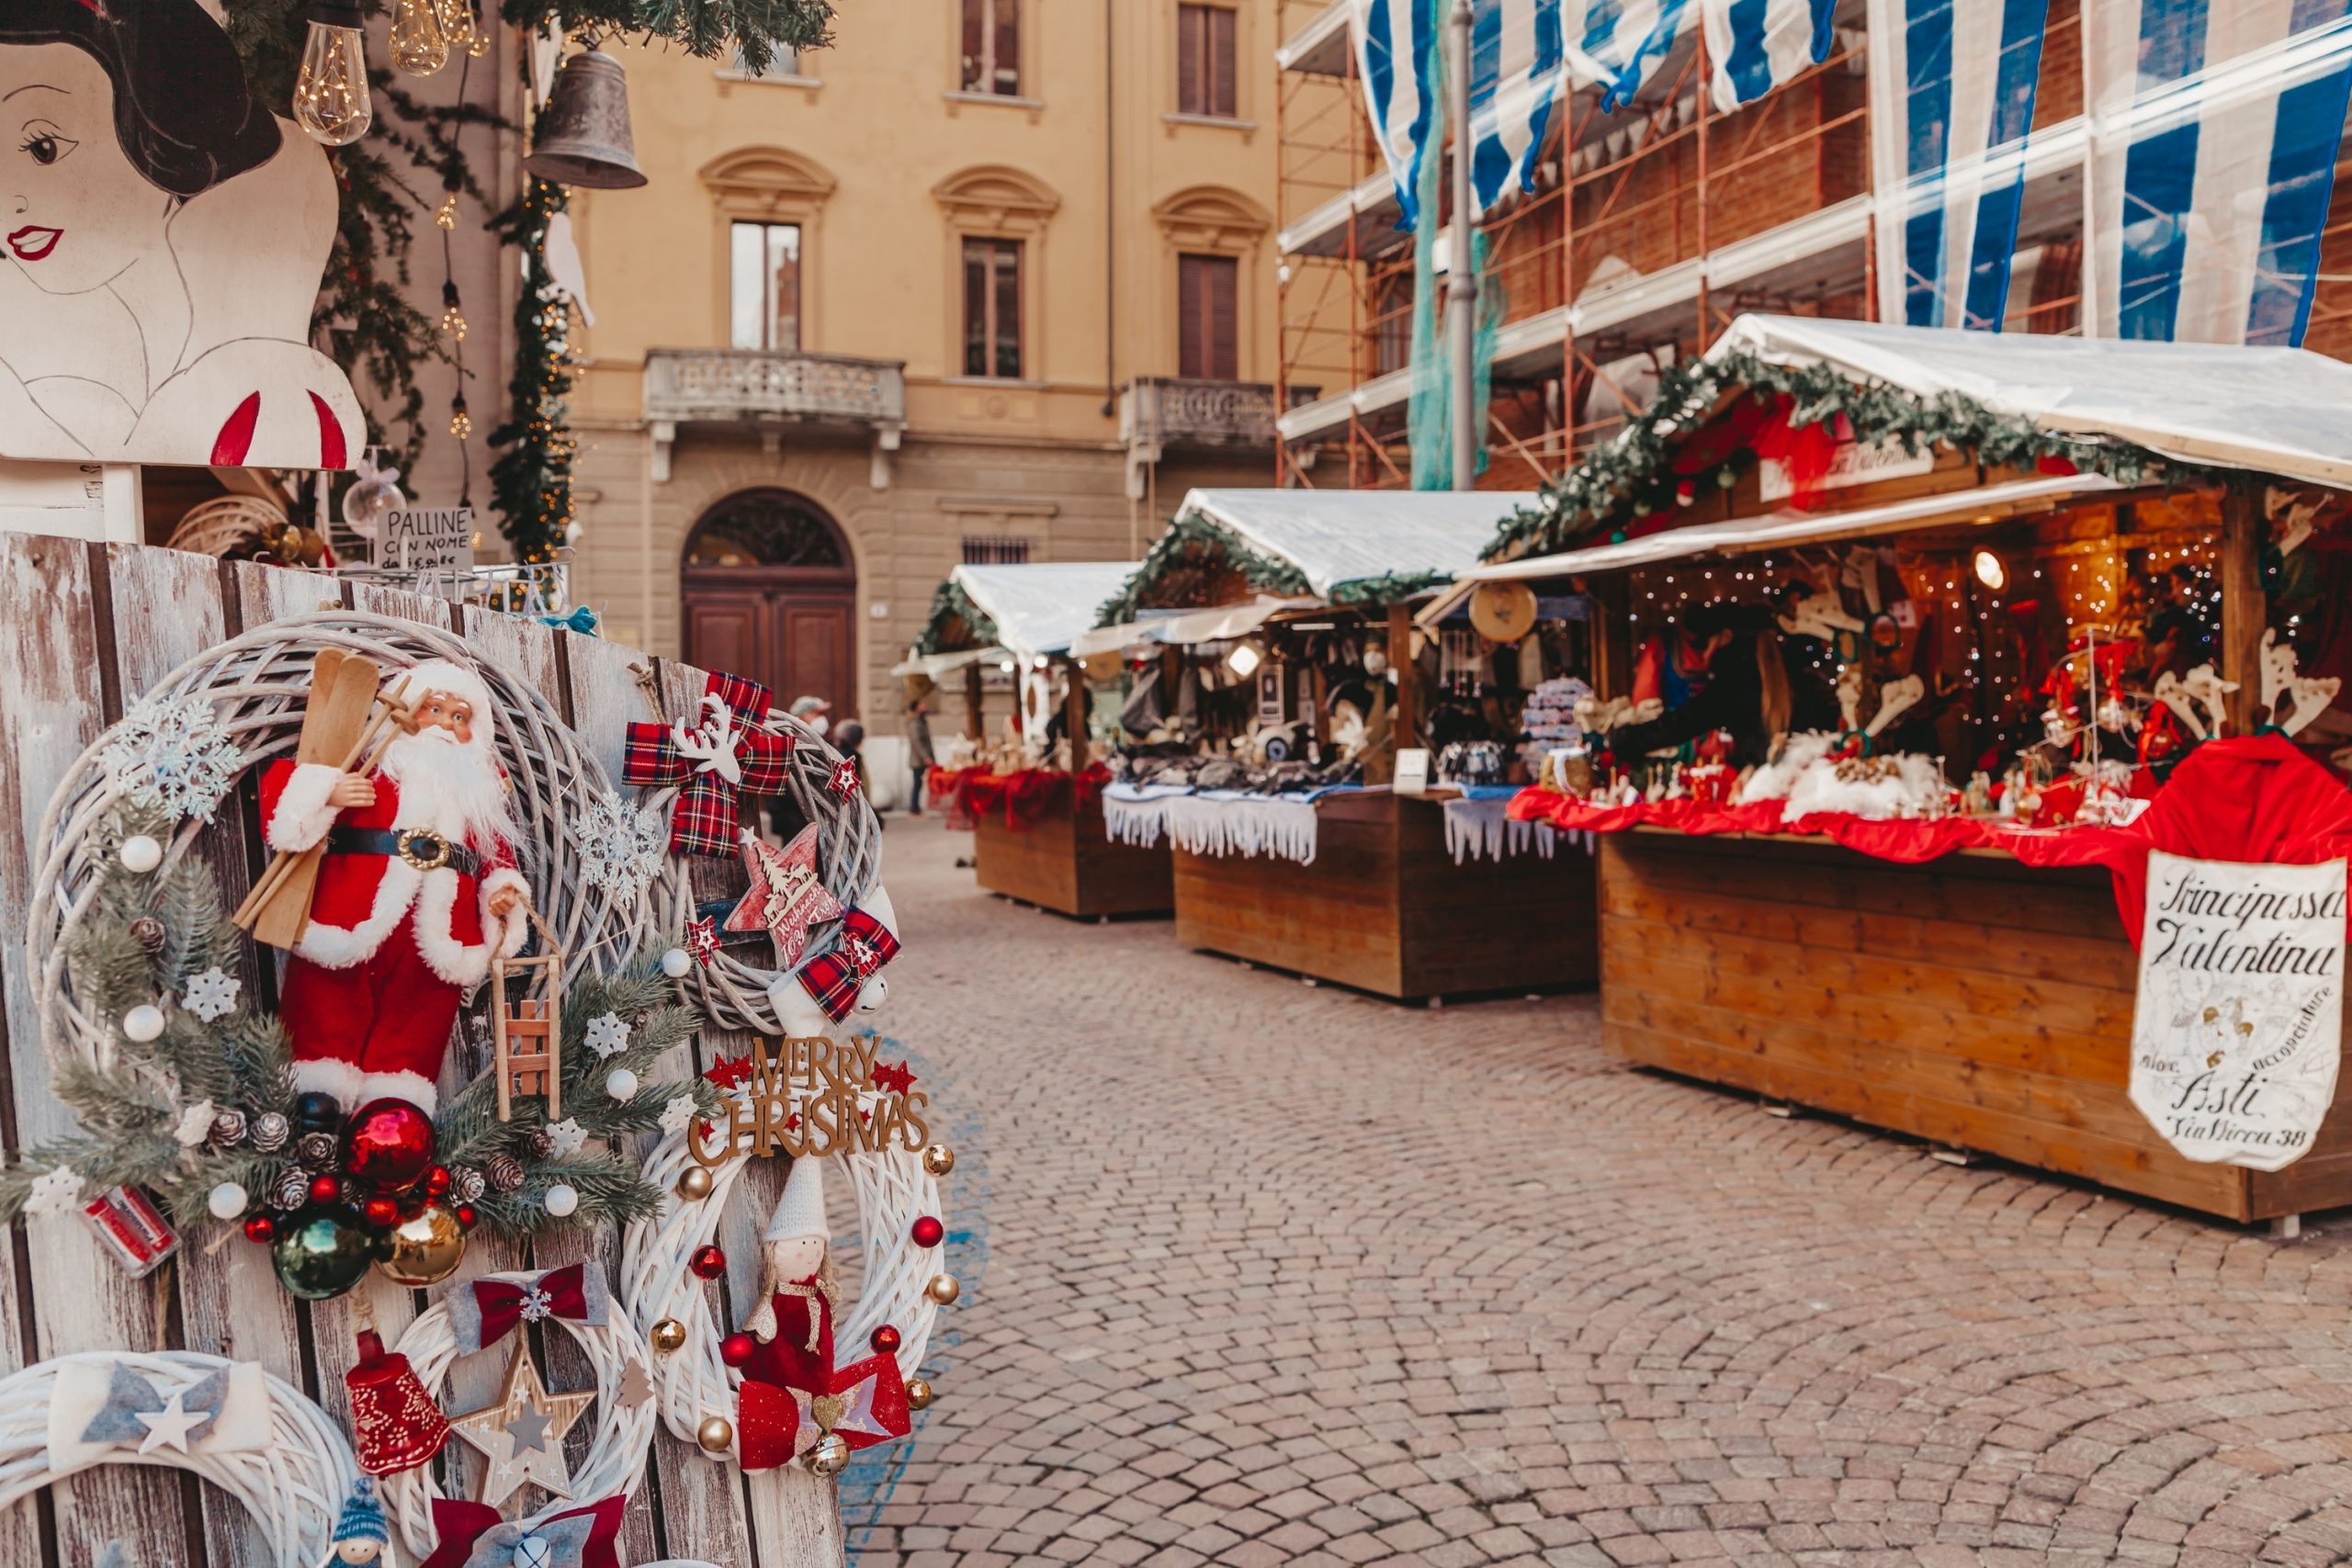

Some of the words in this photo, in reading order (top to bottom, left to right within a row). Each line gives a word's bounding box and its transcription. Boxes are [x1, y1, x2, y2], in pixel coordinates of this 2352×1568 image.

[384, 539, 418, 555] CN
[424, 535, 469, 551] NOME
[388, 509, 468, 536] PALLINE
[2159, 868, 2346, 931] Principessa
[2148, 918, 2335, 976] Valentina
[749, 1035, 883, 1097] MERRY
[2170, 1069, 2267, 1118] Asti
[687, 1089, 929, 1168] CHRISTMAS
[2276, 1128, 2308, 1148] 38
